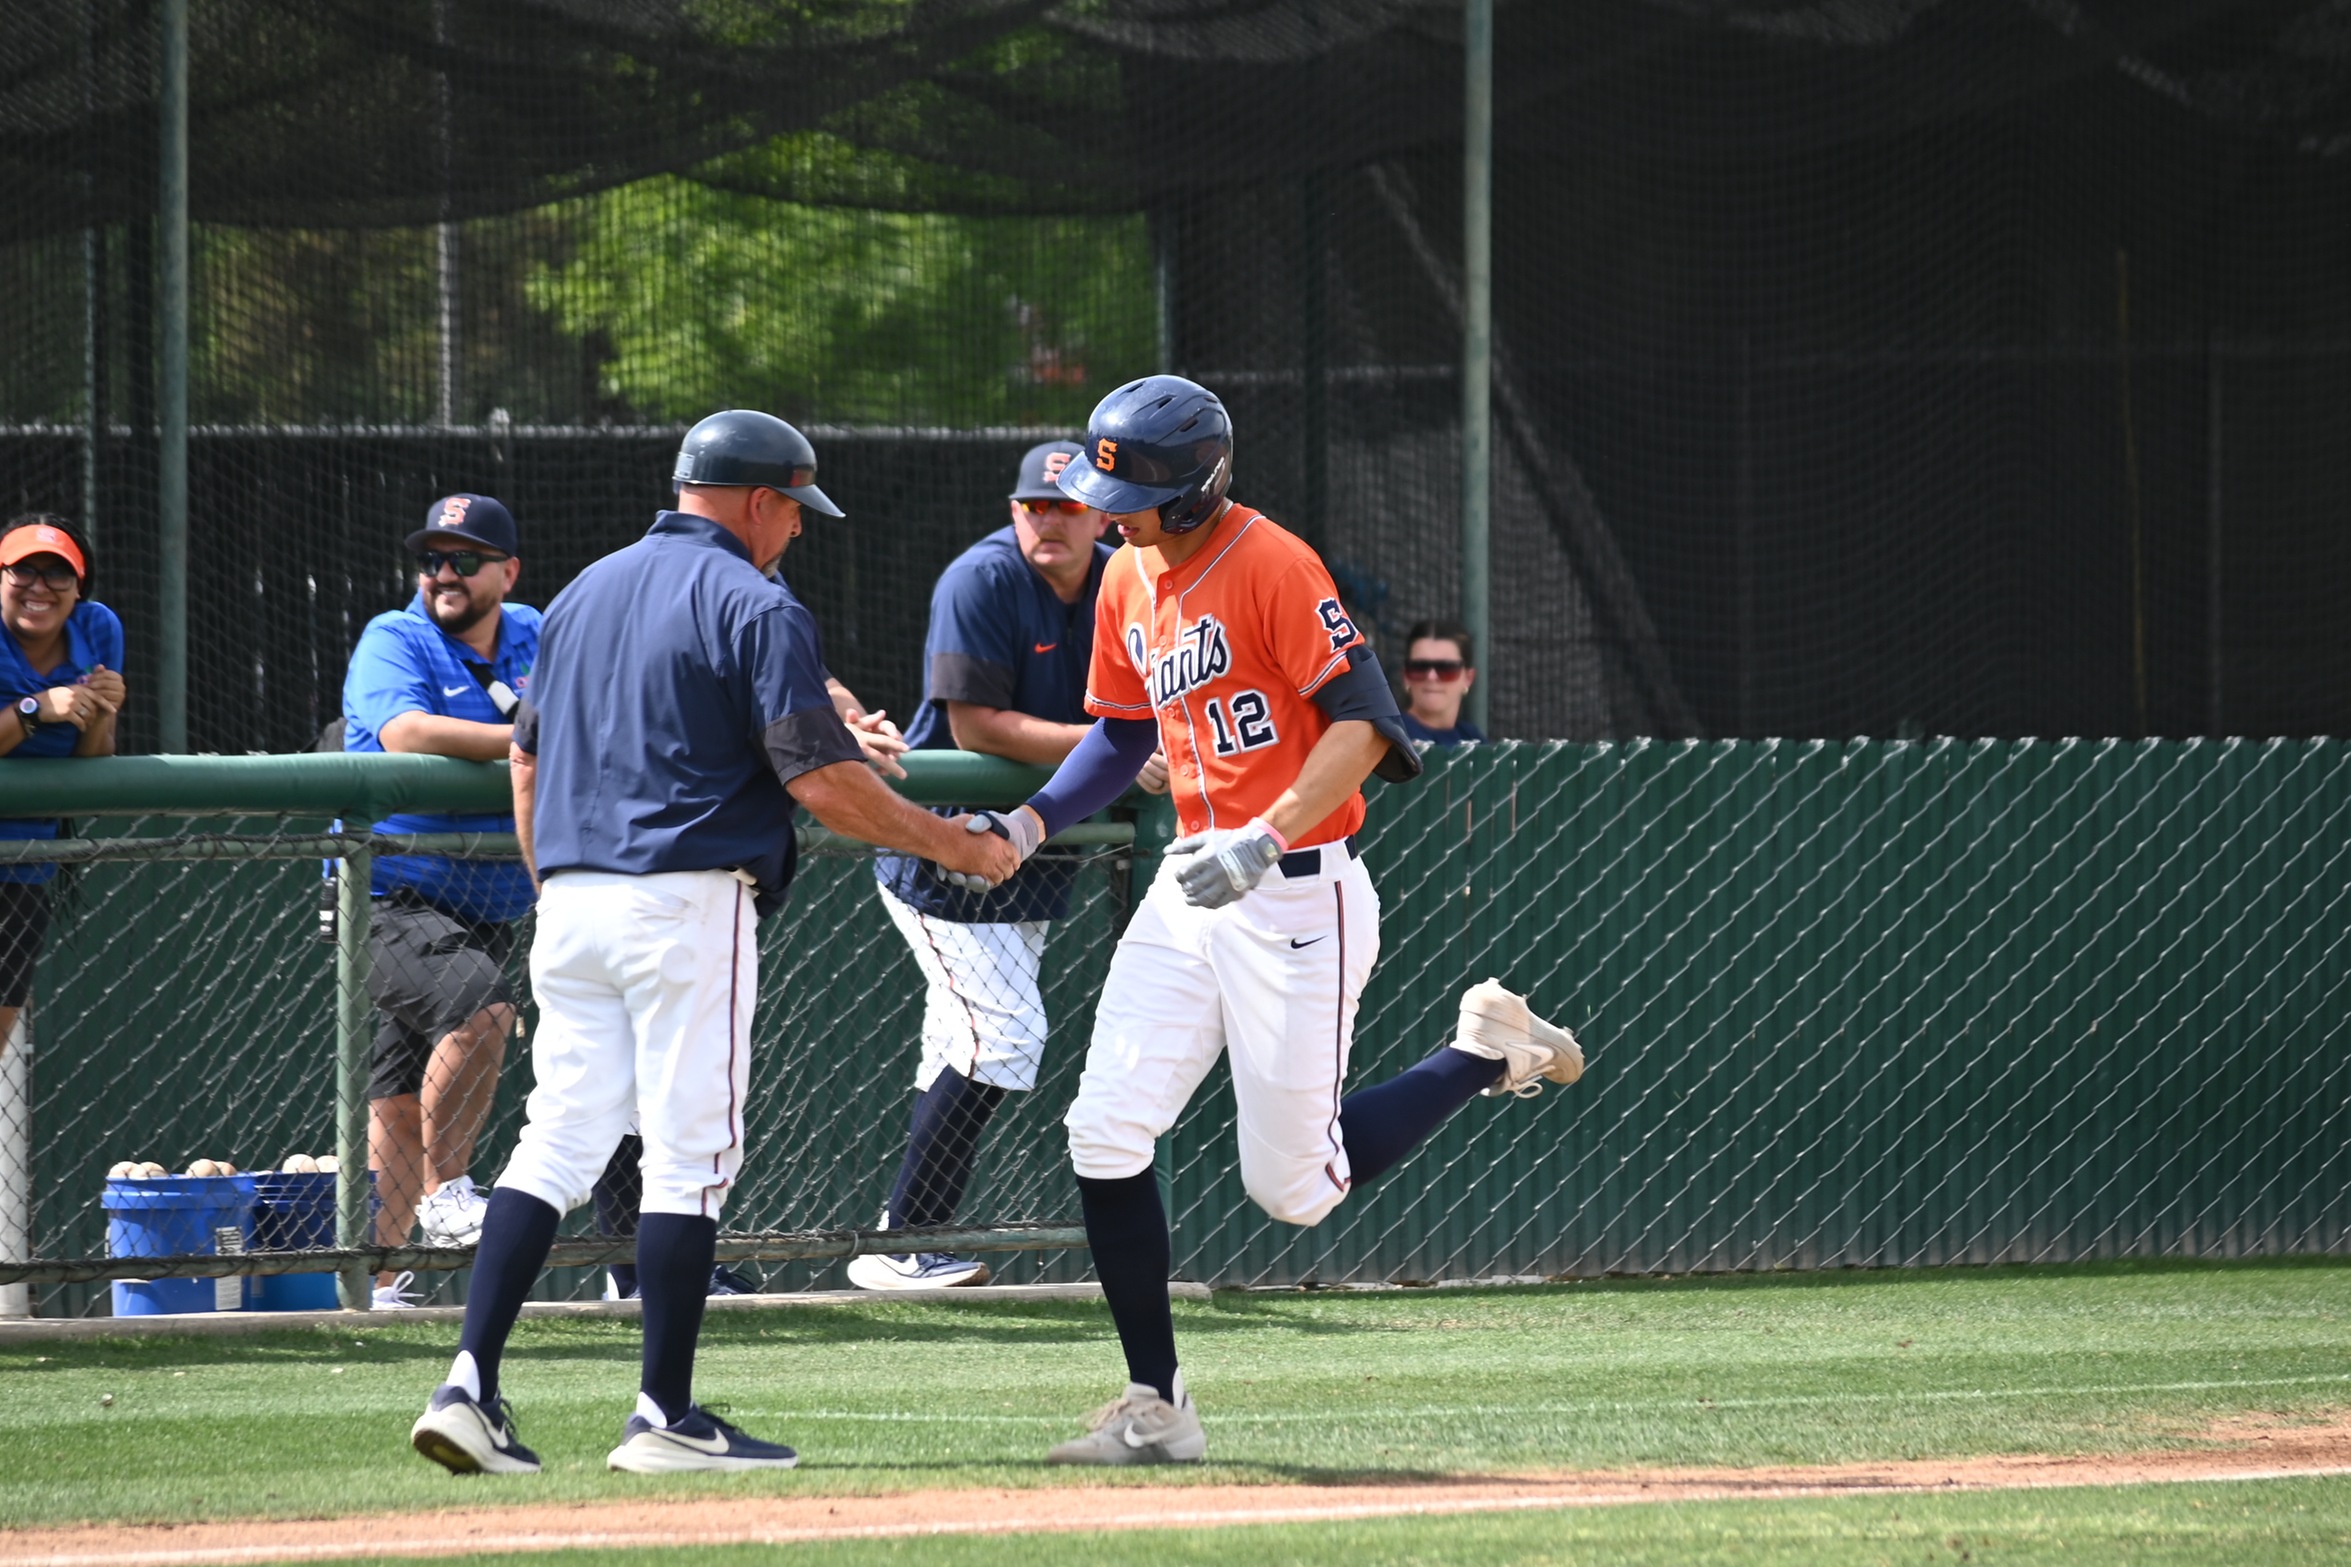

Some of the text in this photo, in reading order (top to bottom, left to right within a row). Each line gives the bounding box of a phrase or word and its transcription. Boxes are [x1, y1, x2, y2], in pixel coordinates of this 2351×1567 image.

[1043, 452, 1071, 483] S
[1096, 438, 1118, 472] S
[438, 497, 471, 527] S
[1314, 597, 1358, 654] S
[1204, 688, 1280, 757] 12
